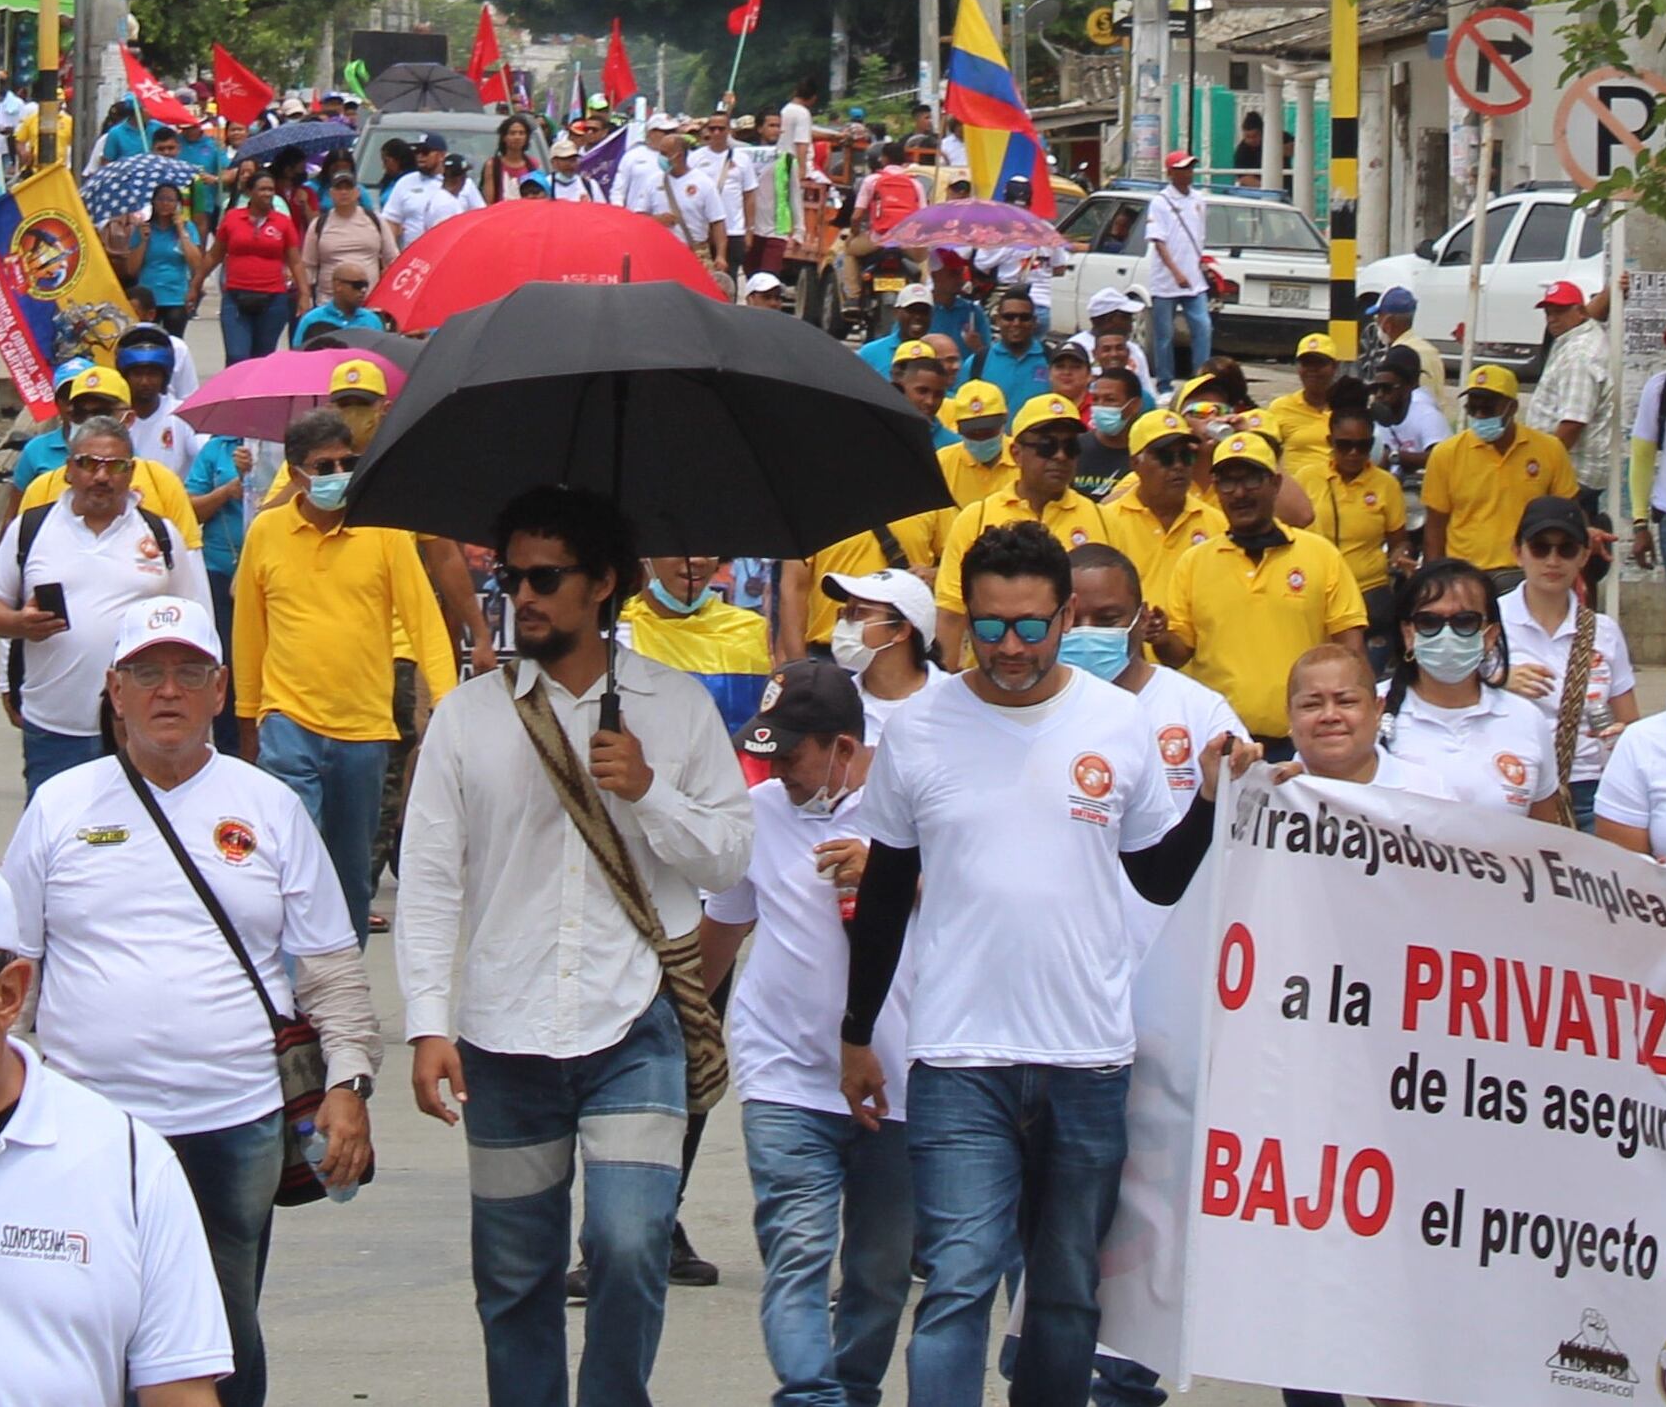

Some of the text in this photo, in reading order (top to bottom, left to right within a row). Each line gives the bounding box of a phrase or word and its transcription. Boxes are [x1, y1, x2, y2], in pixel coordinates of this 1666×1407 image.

[1510, 854, 1535, 903] y
[1281, 974, 1310, 1020] a
[1328, 964, 1371, 1027] la
[1390, 1052, 1447, 1113] de
[1464, 1058, 1528, 1124] las
[1201, 1128, 1394, 1237] BAJO
[1421, 1188, 1465, 1248] el
[1480, 1205, 1658, 1279] proyecto
